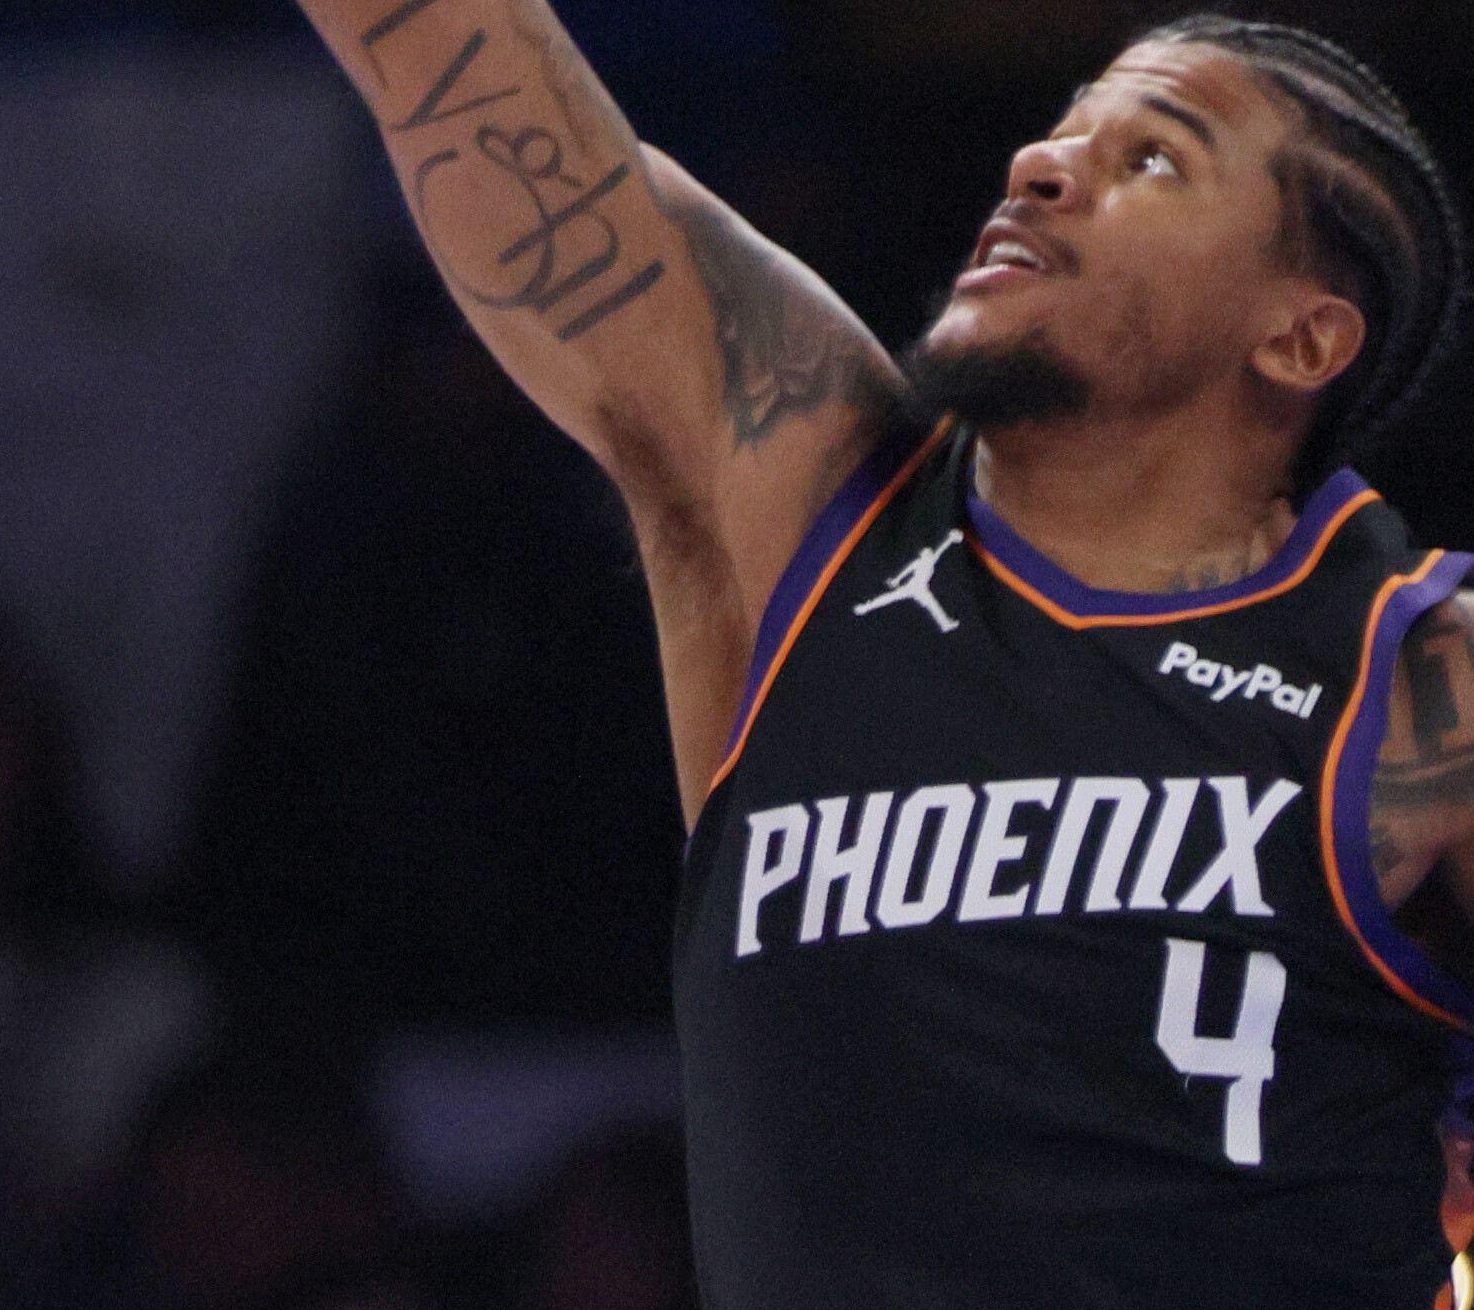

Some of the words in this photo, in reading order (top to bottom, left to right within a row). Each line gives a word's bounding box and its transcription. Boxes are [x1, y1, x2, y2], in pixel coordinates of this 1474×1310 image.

[1159, 641, 1322, 720] PayPal
[734, 775, 1302, 958] PHOENIX
[1156, 938, 1287, 1166] 4
